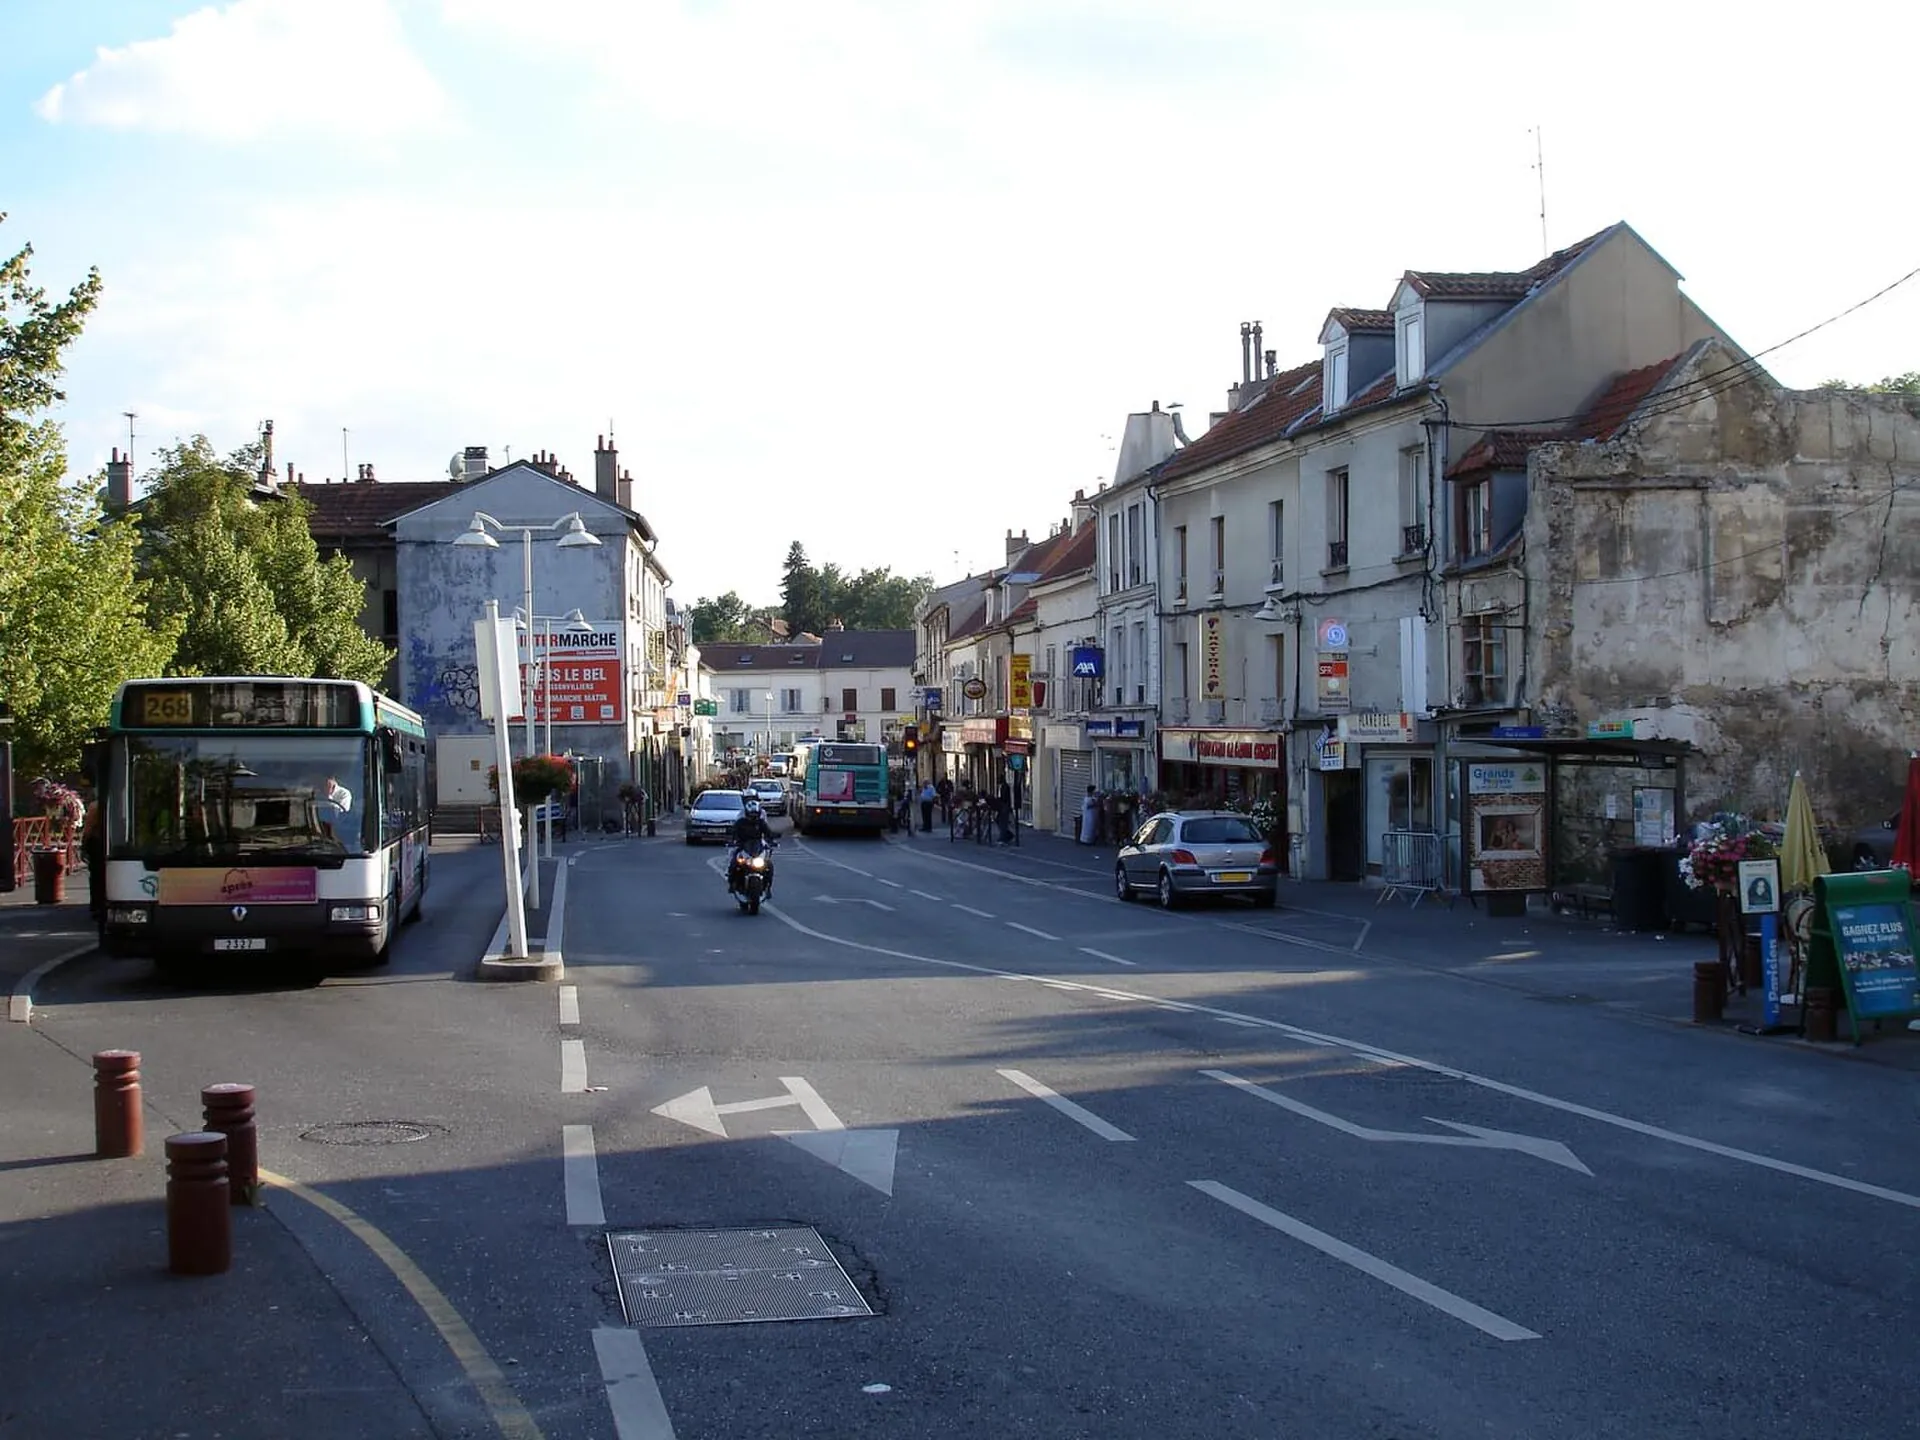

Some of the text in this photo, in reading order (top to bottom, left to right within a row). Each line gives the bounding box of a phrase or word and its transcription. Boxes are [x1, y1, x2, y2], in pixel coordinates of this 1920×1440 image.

[564, 668, 579, 681] LE
[583, 667, 607, 681] BEL
[1073, 661, 1096, 674] AXA
[1318, 665, 1332, 675] SFR
[147, 697, 190, 718] 268
[1473, 767, 1515, 779] Grands
[1880, 921, 1903, 934] PLUS
